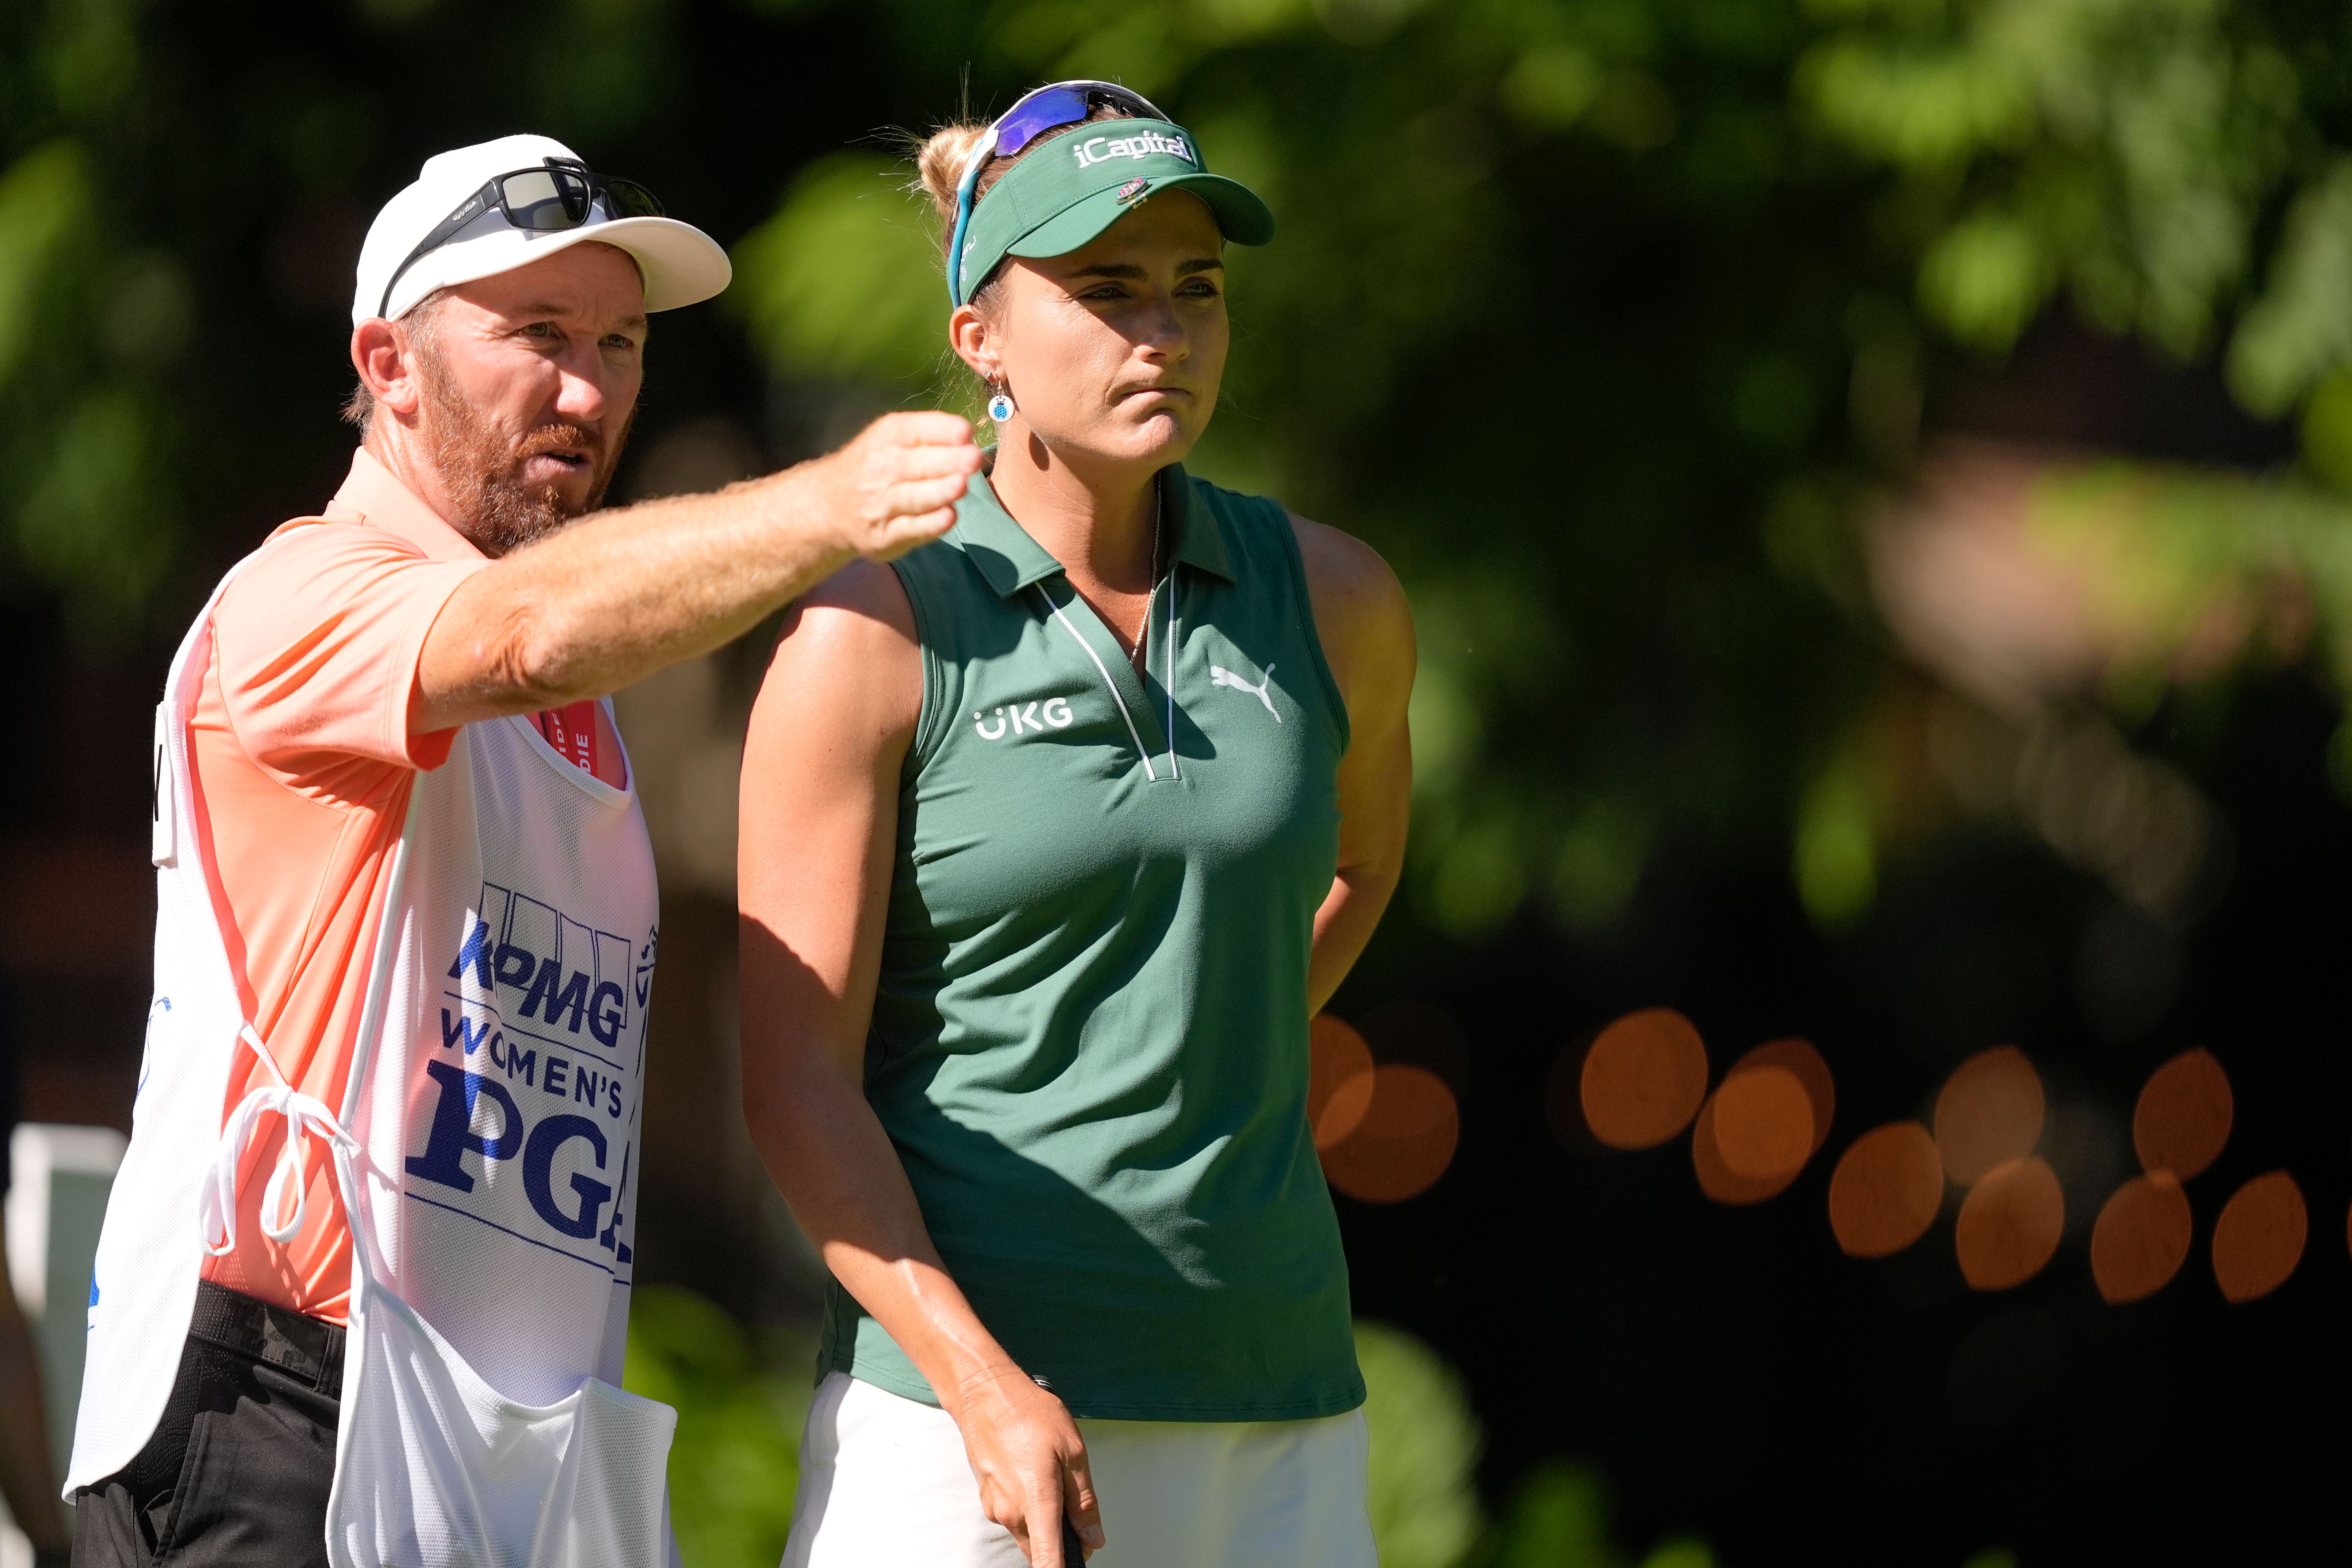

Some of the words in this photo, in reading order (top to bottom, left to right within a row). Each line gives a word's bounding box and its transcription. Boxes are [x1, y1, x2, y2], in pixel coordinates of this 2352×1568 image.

[1073, 130, 1192, 168] iCapital
[448, 917, 625, 1047] KPMG
[442, 1008, 621, 1118] WOMEN'S
